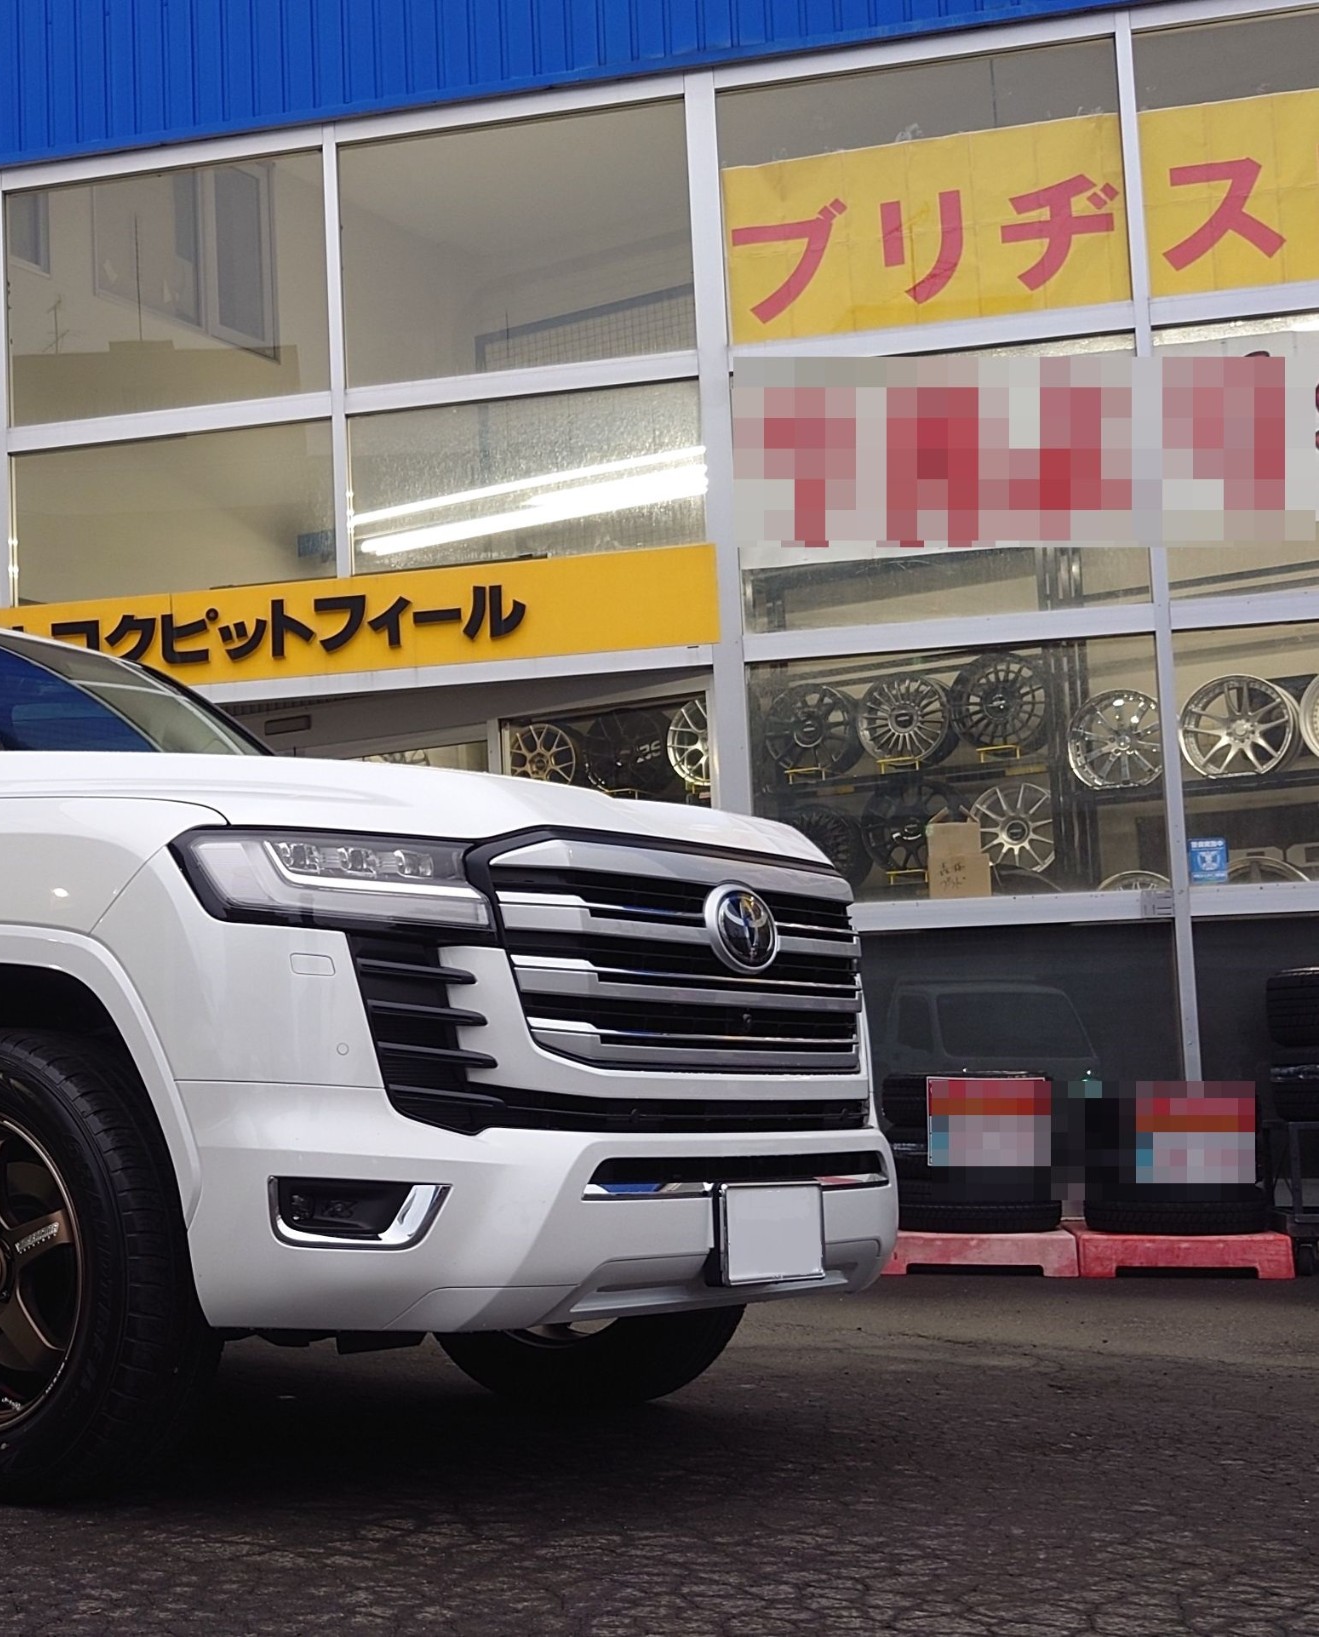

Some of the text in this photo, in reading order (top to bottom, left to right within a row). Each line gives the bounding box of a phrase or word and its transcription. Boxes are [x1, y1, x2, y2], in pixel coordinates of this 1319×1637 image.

[12, 584, 526, 664] コクピットフィール
